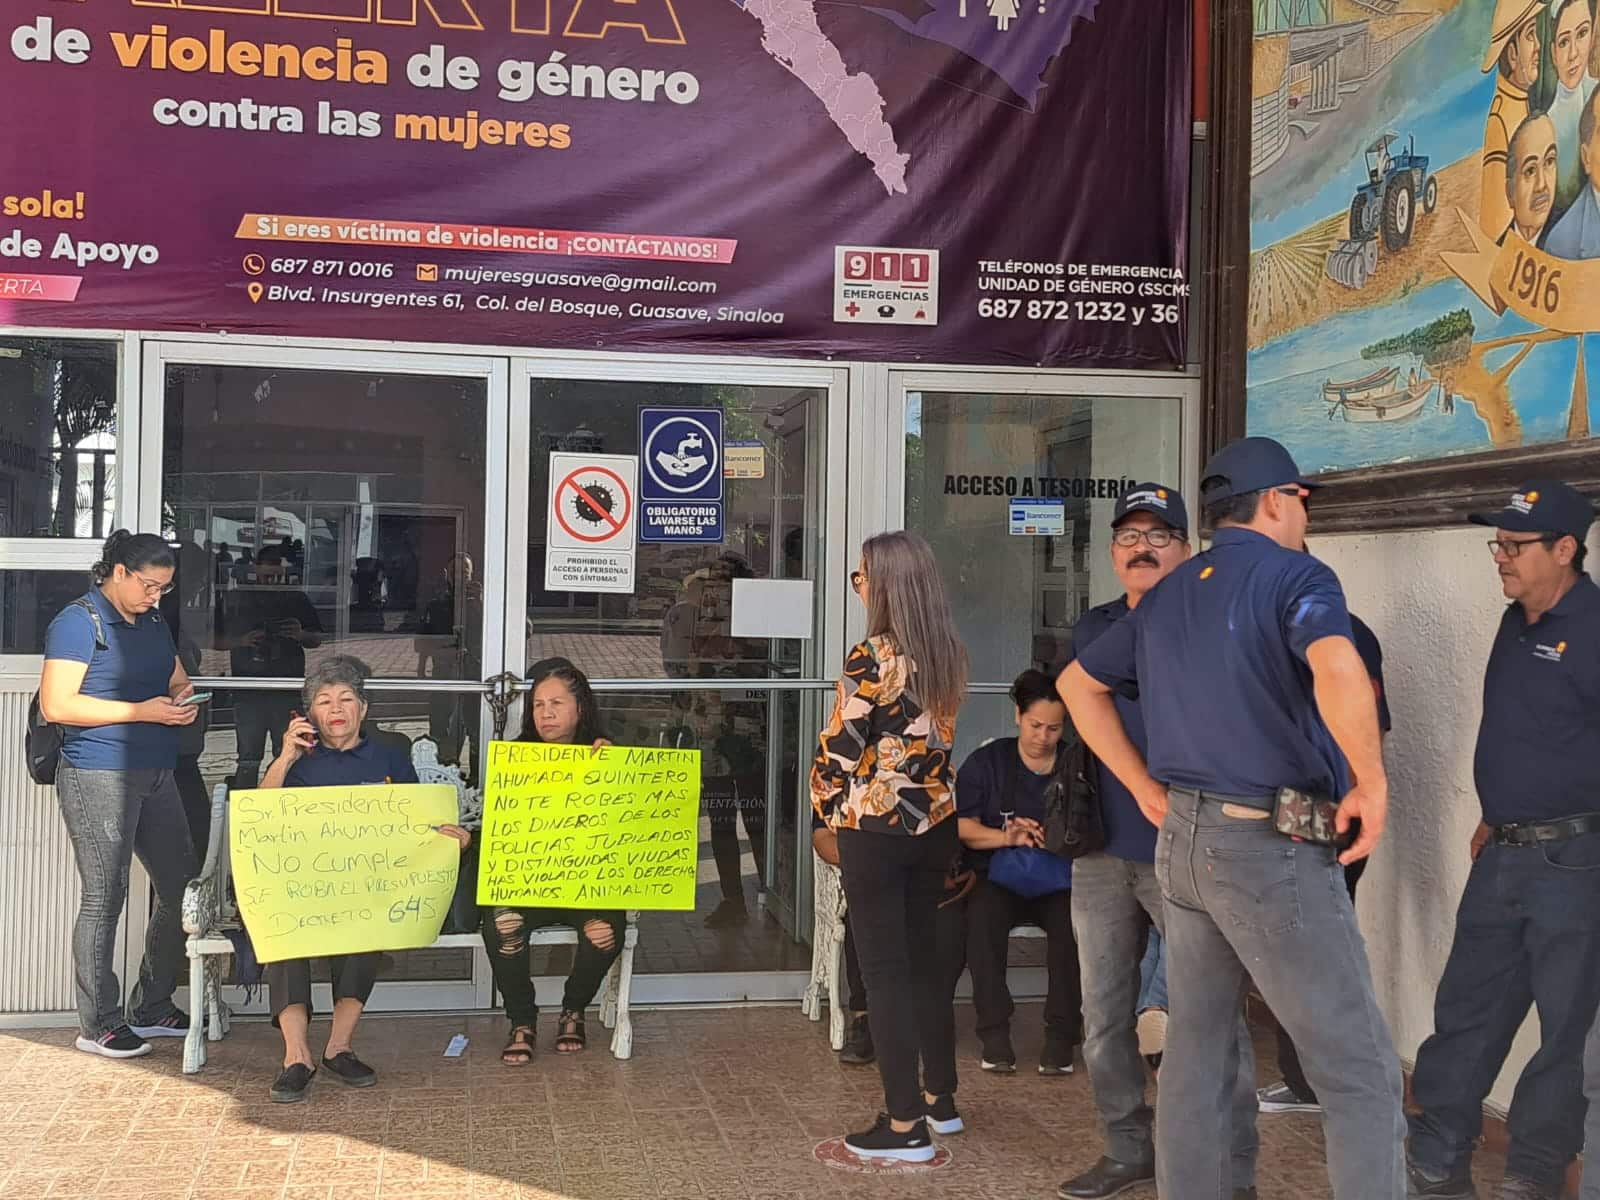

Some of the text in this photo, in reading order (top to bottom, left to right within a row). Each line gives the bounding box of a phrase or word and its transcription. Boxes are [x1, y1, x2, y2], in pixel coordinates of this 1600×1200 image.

[10, 16, 91, 64] de
[110, 24, 388, 84] violencia
[406, 44, 480, 89] de
[497, 50, 700, 105] género
[153, 97, 572, 150] contra las mujeres
[3, 190, 85, 219] sola!
[256, 216, 718, 259] Si eres víctima de violencia ¡CONTÁCTANOS!
[0, 229, 159, 270] de Apoyo
[270, 258, 394, 278] 687 871 0016
[978, 259, 1184, 280] TELÉFONOS DE EMERGENCIA
[444, 267, 717, 294] mujeresguasave@gmail.com
[978, 277, 1040, 292] UNIDAD
[1044, 280, 1065, 293] DE
[1069, 278, 1134, 295] GÉNERO
[1508, 250, 1562, 313] 1916
[267, 285, 785, 324] Blvd. Insurgentes 61, Col. del Bosque, Guasave, Sinaloa
[843, 289, 929, 301] EMERGENCIAS
[978, 298, 1179, 326] 687 872 1232 y 36
[944, 474, 1017, 497] ACCESO
[1021, 476, 1035, 497] A
[646, 506, 717, 516] OBLIGATORIO
[649, 516, 717, 526] LAVARSE LAS
[664, 526, 703, 535] MANOS
[552, 565, 582, 573] ACCESO
[567, 557, 608, 565] PROHIBIDO
[624, 749, 694, 766] MARTIN
[491, 770, 688, 788] AHUMADA QUINTERO
[279, 790, 412, 817] Presidente
[494, 789, 689, 811] NO TE ROBES MAS
[321, 817, 433, 839] Ahumada
[491, 808, 680, 837] LOS DINEROS DE LOS
[505, 852, 619, 872] DISTINGUIDAS
[627, 848, 690, 866] VIUDAS
[487, 874, 515, 887] HAS
[523, 869, 589, 885] VIOLADO
[596, 866, 625, 881] LOS
[575, 883, 673, 902] ANIMALITO
[388, 895, 436, 924] 645
